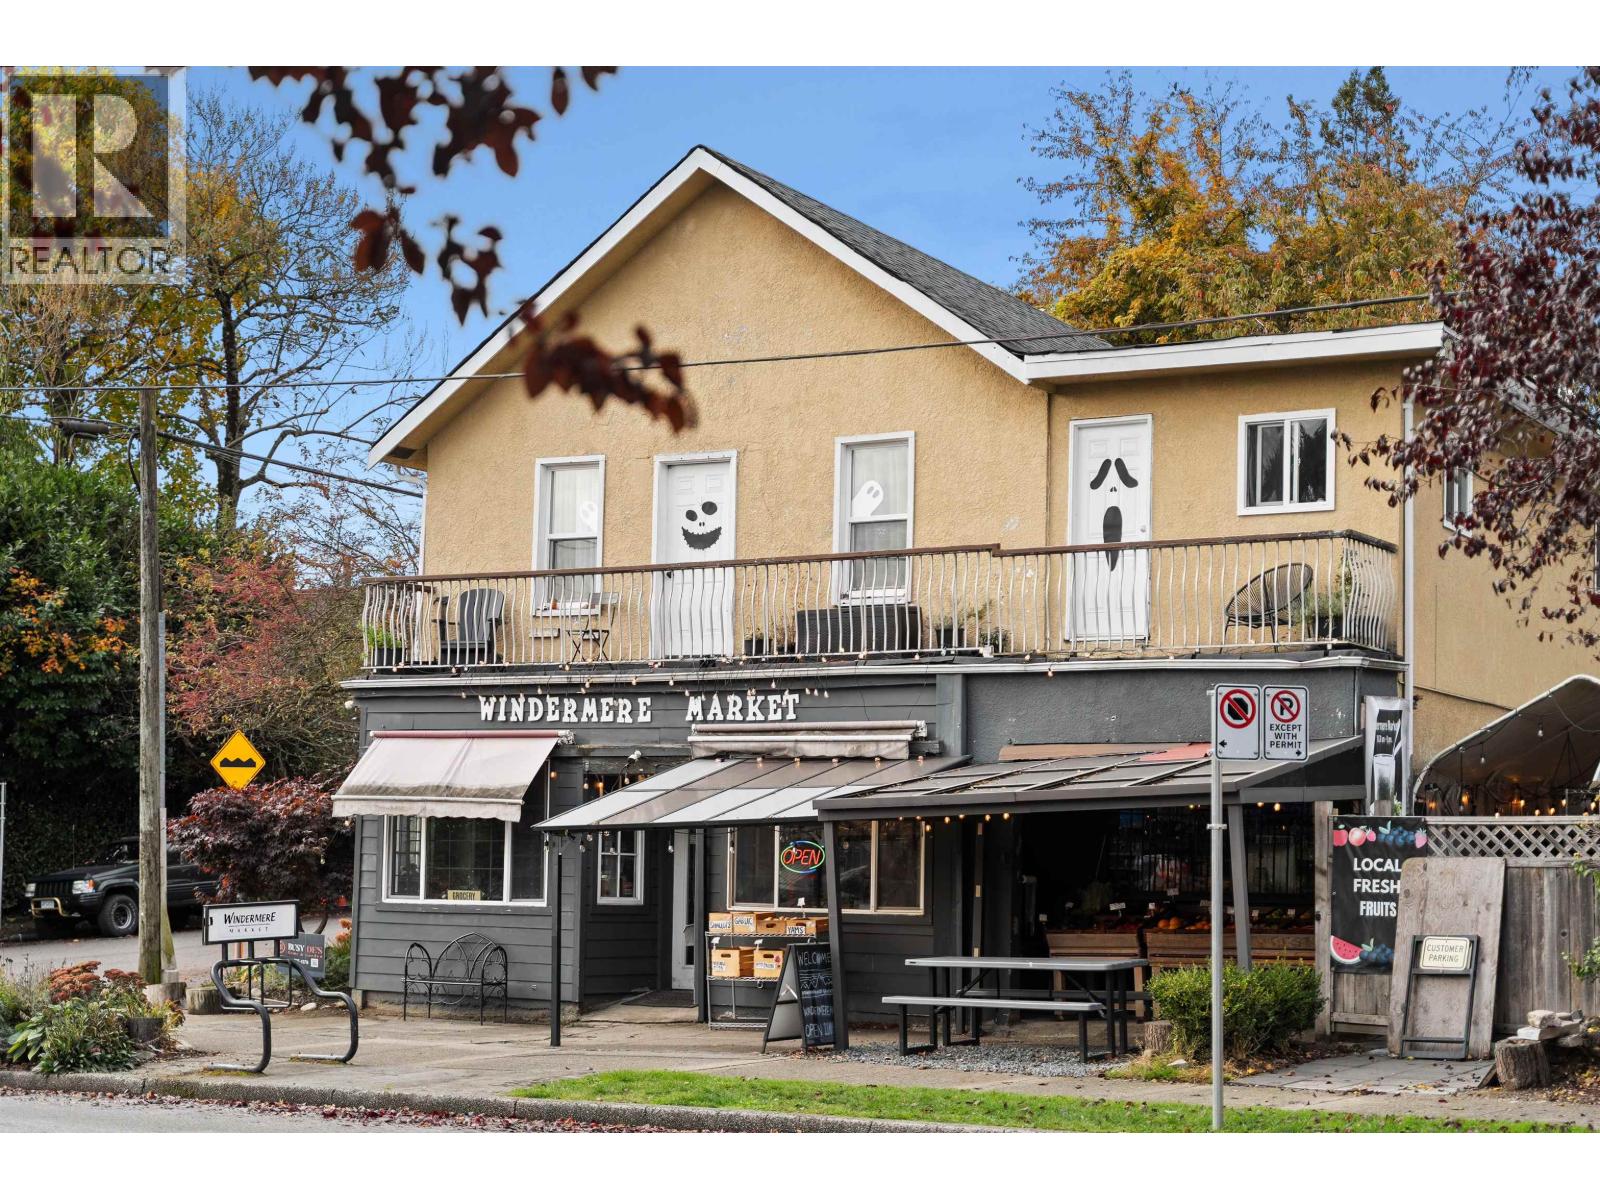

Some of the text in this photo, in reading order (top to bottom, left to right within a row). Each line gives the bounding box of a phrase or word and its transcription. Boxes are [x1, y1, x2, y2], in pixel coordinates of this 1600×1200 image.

[478, 693, 800, 723] WINDERMERE MARKET
[1269, 723, 1303, 732] EXCEPT
[1274, 732, 1298, 740] WITH
[1269, 741, 1303, 749] PERMIT
[783, 849, 821, 865] OPEN
[1353, 857, 1402, 872] LOCAL
[1353, 878, 1400, 894] FRESH
[1359, 901, 1397, 917] FRUITS
[224, 911, 276, 925] WINDERMERE
[787, 926, 804, 934] YAMS
[1426, 944, 1465, 953] CUSTOMER
[1428, 953, 1460, 962] PARKING
